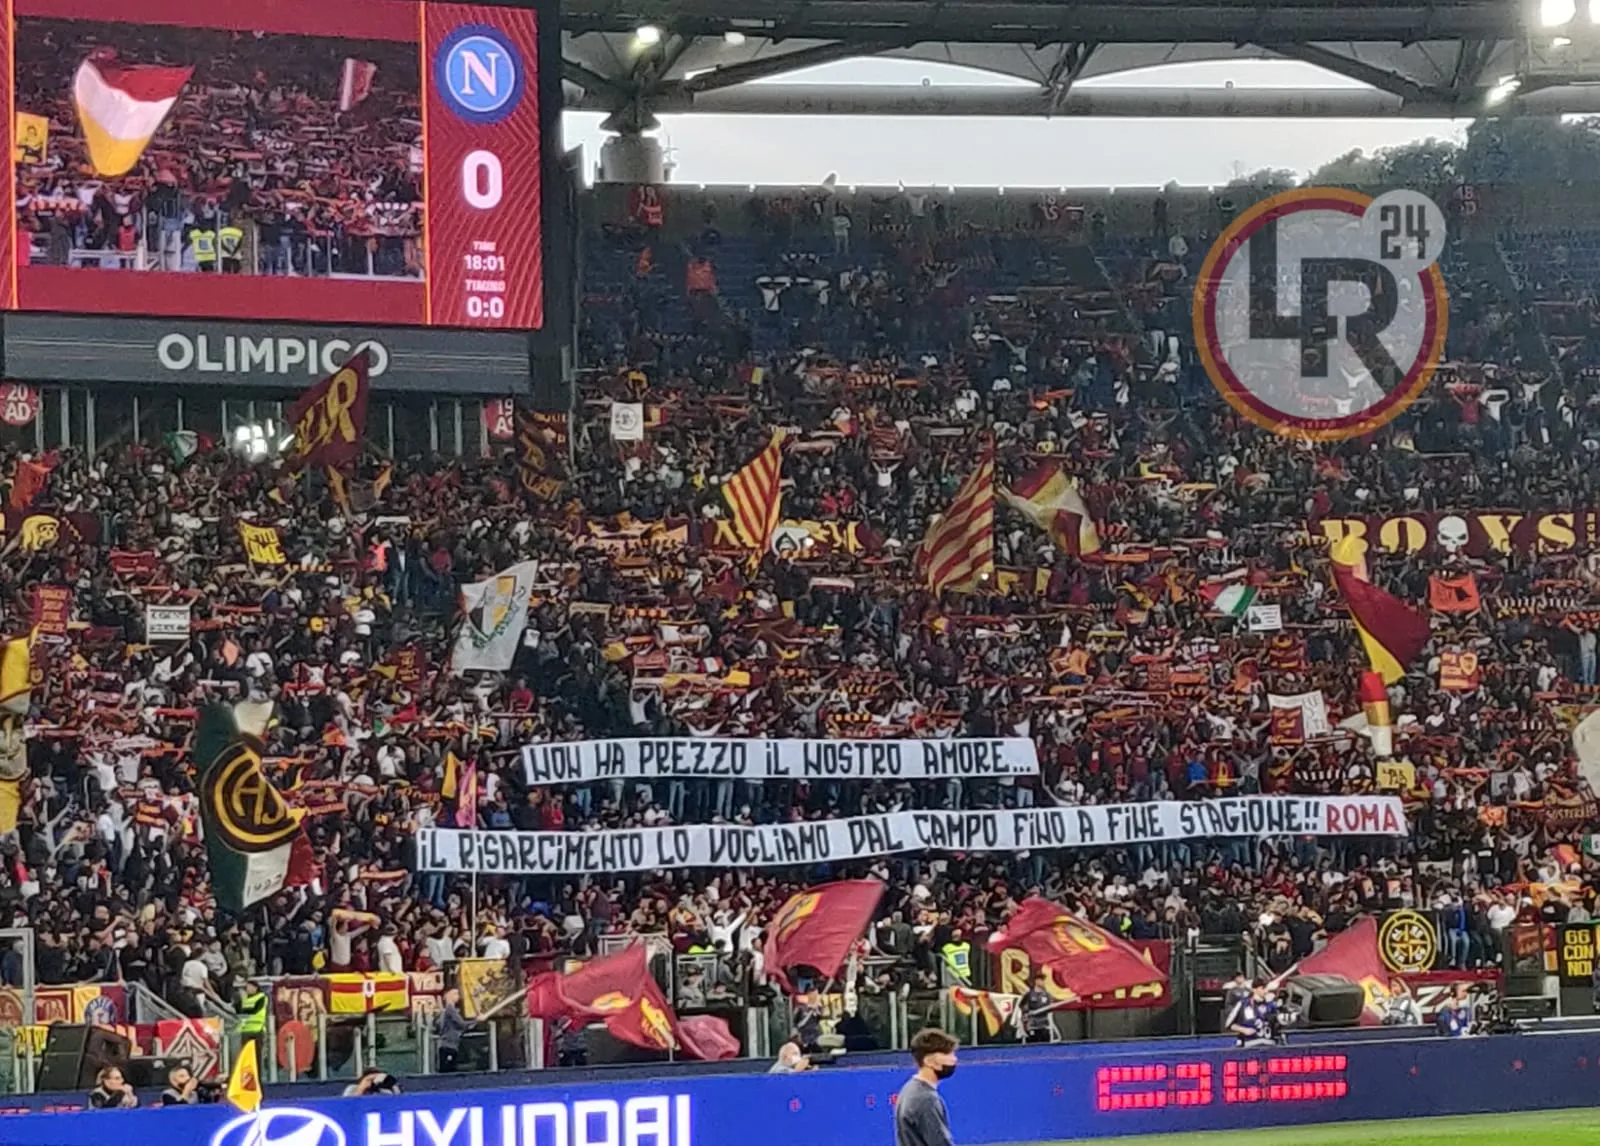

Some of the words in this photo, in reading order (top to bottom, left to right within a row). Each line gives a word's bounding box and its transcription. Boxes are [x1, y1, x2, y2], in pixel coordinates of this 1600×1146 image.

[461, 50, 500, 96] N
[463, 150, 503, 209] 0
[464, 254, 505, 271] 18:01
[467, 296, 505, 318] 0:0
[158, 333, 389, 377] OLIMPICO
[5, 402, 31, 421] AD
[595, 742, 627, 777] HA
[638, 741, 748, 776] PREZZO
[804, 741, 901, 776] NOSTRO
[657, 829, 690, 865] LO
[848, 817, 904, 855] DAL
[913, 813, 998, 848] CAMPO
[1077, 809, 1096, 843] A
[1326, 803, 1401, 833] ROMA
[1564, 945, 1594, 960] CON
[1567, 961, 1593, 976] NOI
[364, 1094, 692, 1146] HYUNDAI
